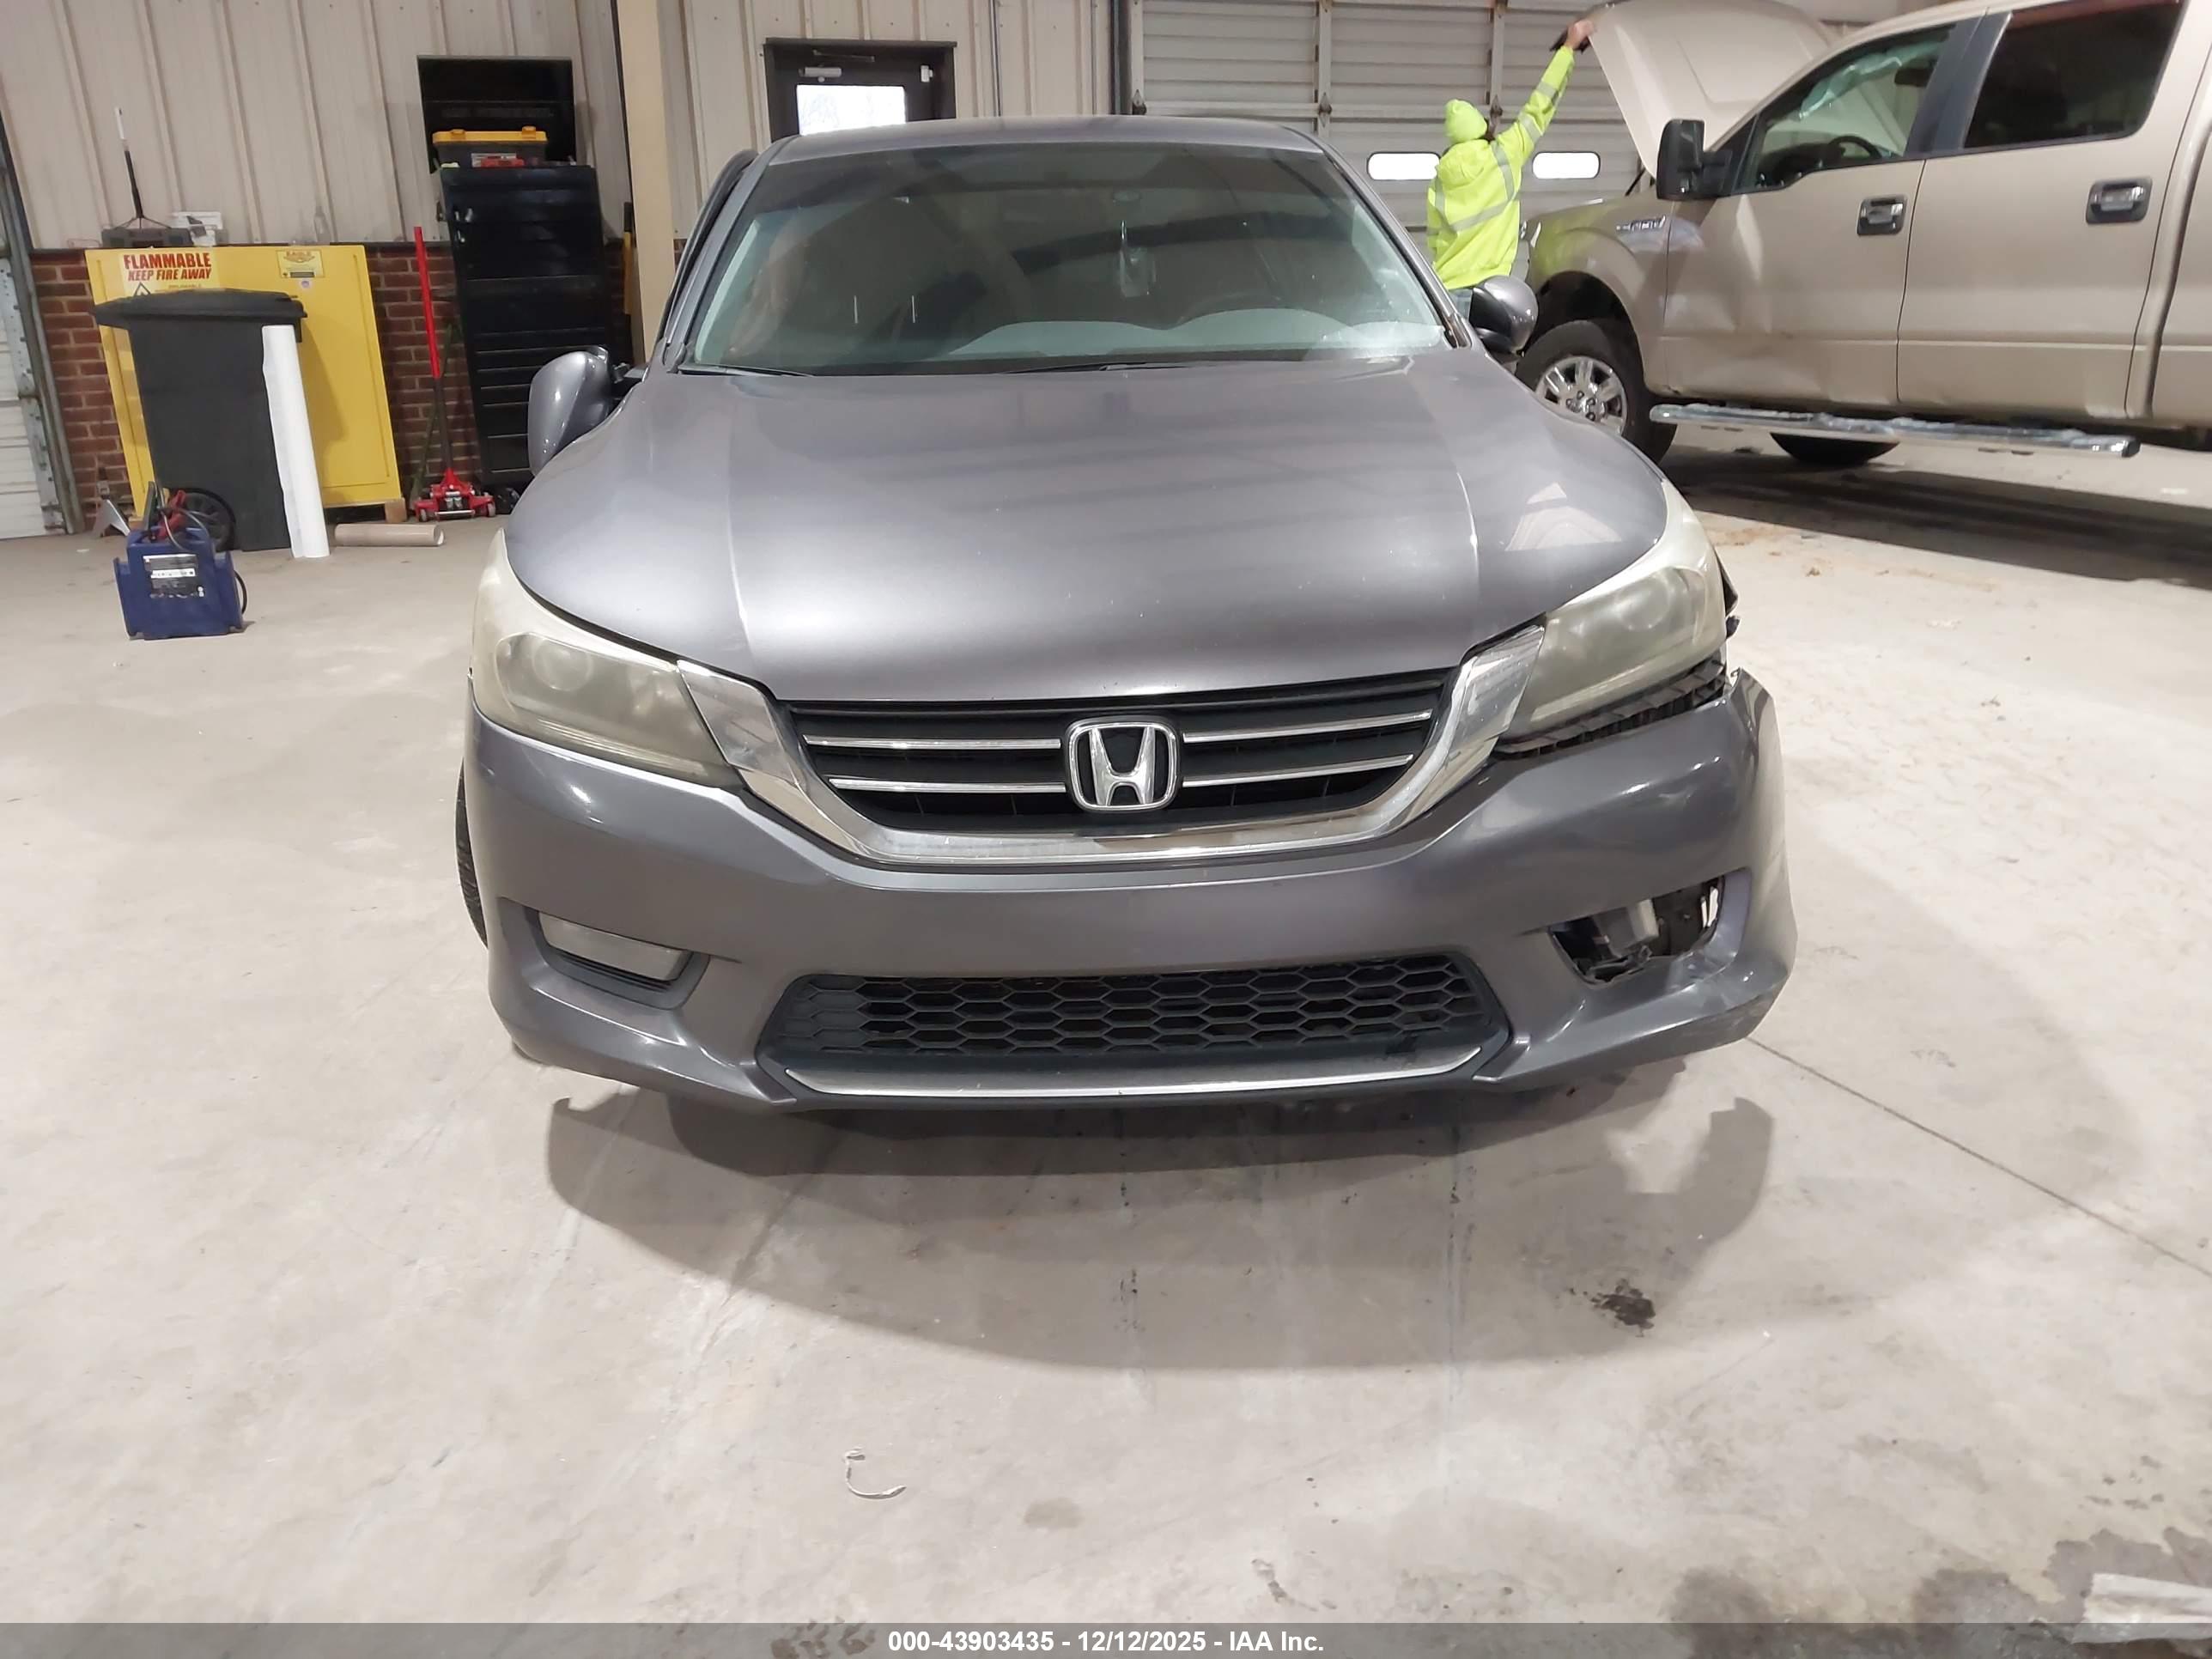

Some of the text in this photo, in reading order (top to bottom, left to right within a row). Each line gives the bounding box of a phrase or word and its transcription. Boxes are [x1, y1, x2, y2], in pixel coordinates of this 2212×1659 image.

[123, 252, 211, 269] FLAMMABLE
[128, 268, 211, 282] KEEP FIRE AWAY
